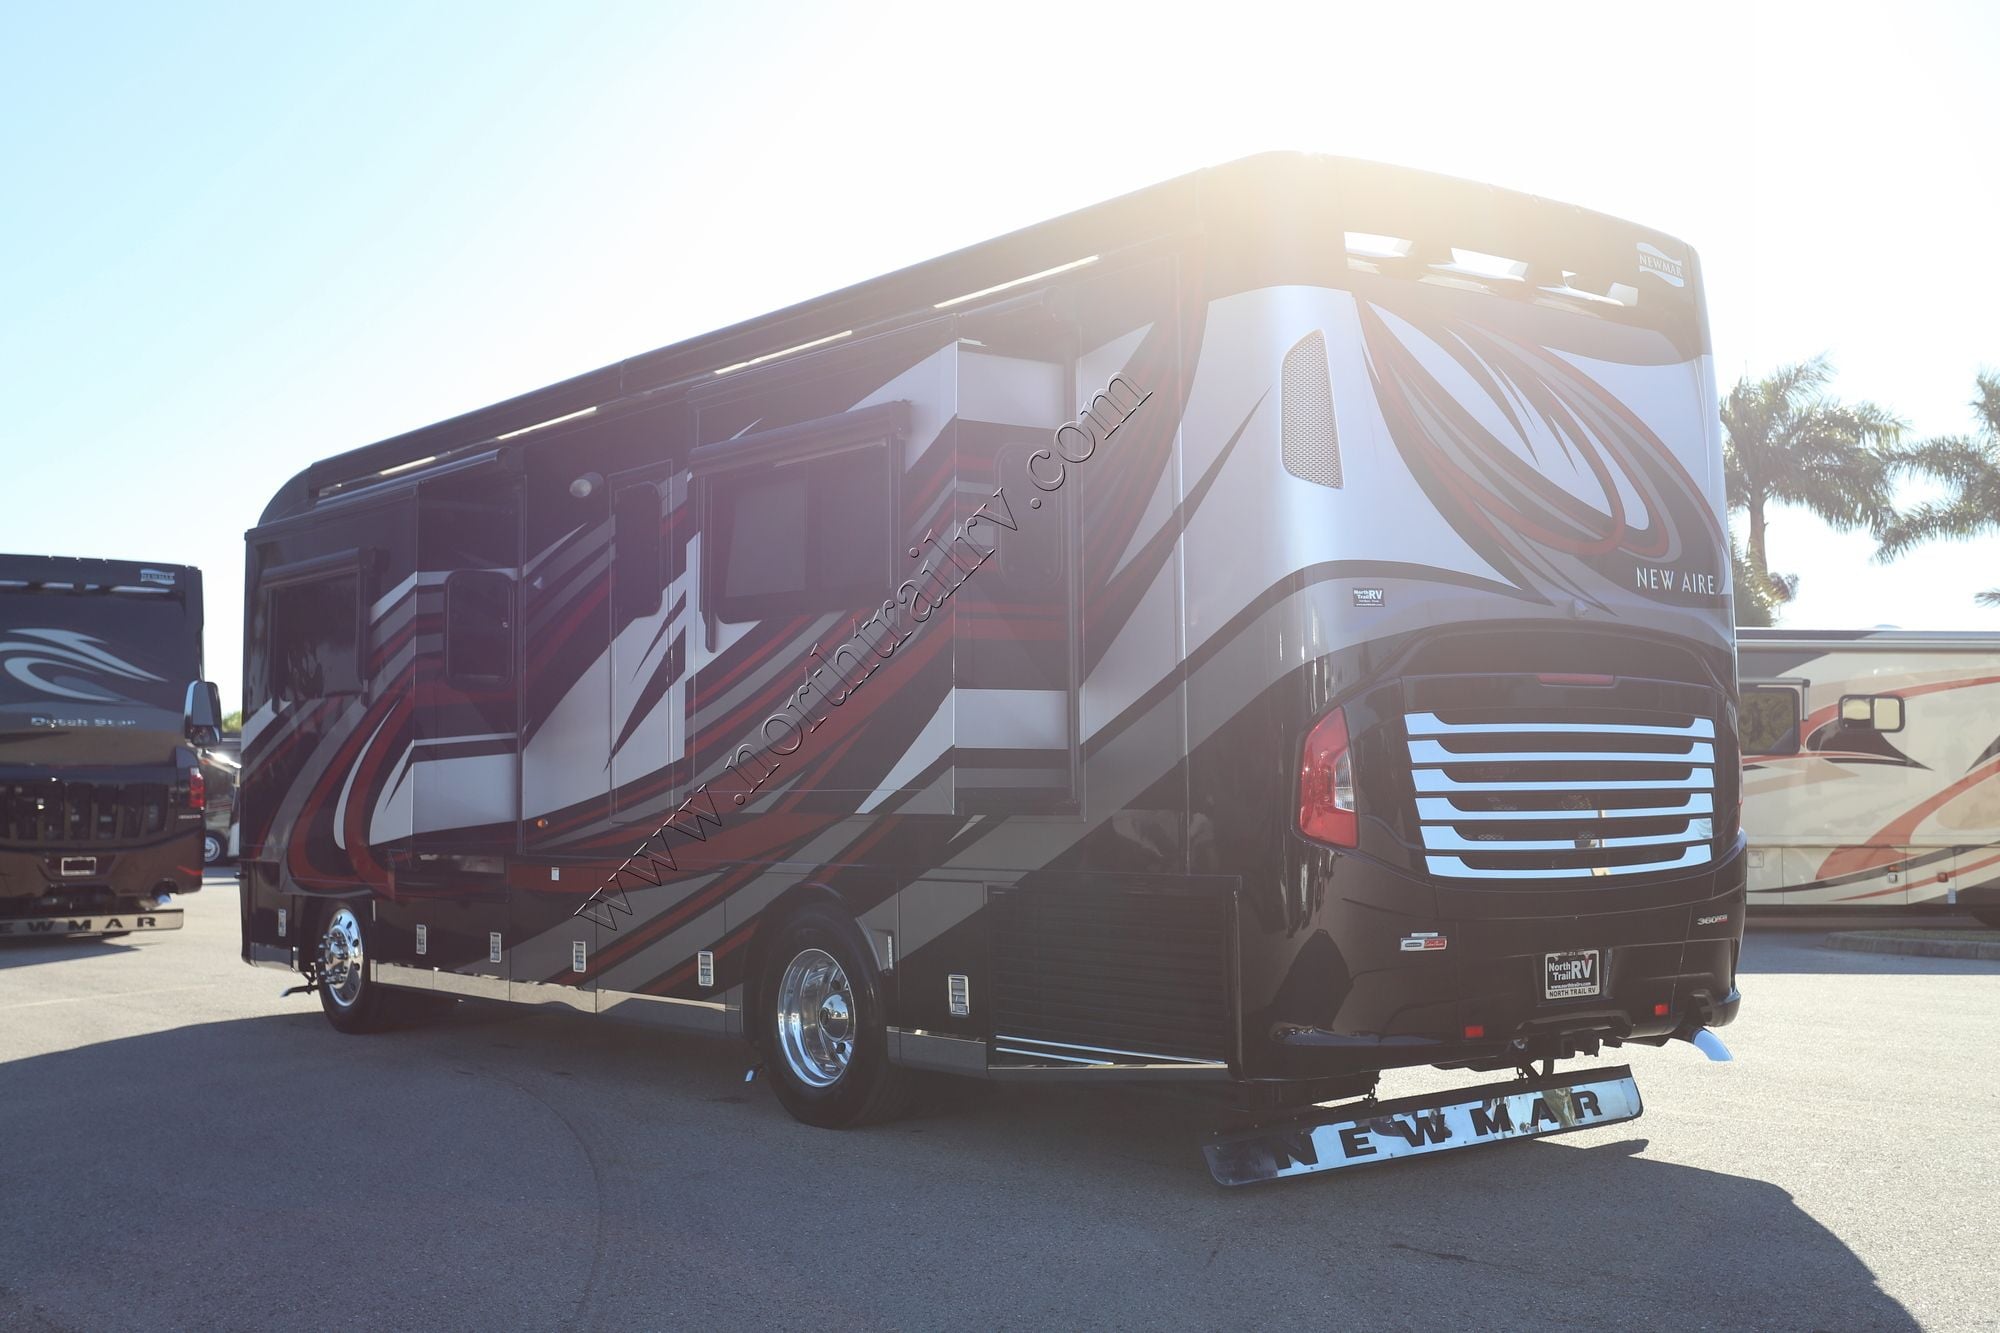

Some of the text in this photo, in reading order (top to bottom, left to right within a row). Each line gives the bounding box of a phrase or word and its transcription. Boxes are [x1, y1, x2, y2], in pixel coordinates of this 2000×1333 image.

[1639, 253, 1682, 277] NEWMAR
[1636, 567, 1715, 595] NEW AIRE
[1369, 590, 1382, 599] RV
[0, 917, 156, 934] EWMAR
[1548, 960, 1592, 979] North RV
[1553, 971, 1571, 981] Trail
[1273, 1090, 1604, 1170] NEWMAR
